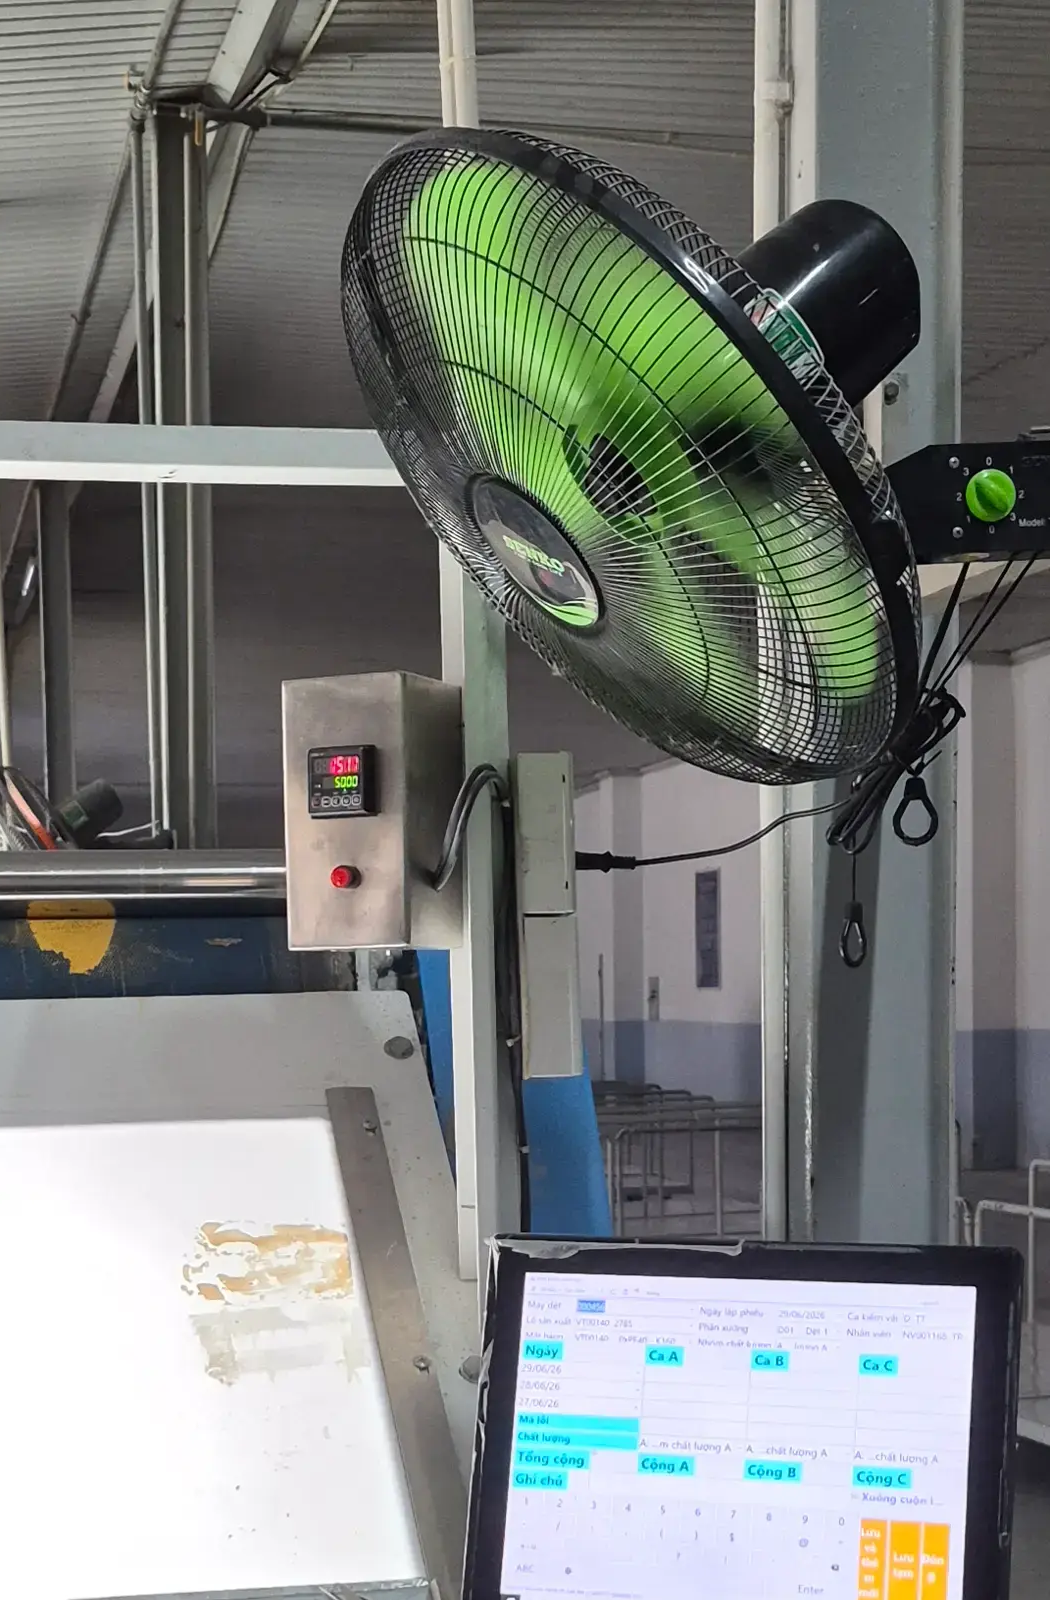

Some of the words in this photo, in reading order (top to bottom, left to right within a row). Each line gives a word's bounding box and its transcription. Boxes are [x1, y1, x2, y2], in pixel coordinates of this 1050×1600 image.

[986, 456, 992, 466] 0
[963, 467, 969, 476] 3
[1009, 465, 1014, 474] 1
[956, 492, 962, 501] 2
[1018, 490, 1025, 499] 2
[966, 515, 970, 523] 1
[1010, 512, 1016, 521] 3
[989, 525, 995, 534] 0
[334, 775, 359, 788] 5000
[649, 1351, 664, 1361] Ca
[669, 1351, 679, 1361] A
[755, 1355, 770, 1366] Ca
[776, 1356, 784, 1366] B
[863, 1359, 879, 1370] Ca
[884, 1360, 893, 1371] C
[641, 1458, 675, 1473] Cộng
[680, 1461, 689, 1471] A
[747, 1464, 782, 1480] Cộng
[788, 1467, 796, 1477] B
[515, 1473, 536, 1485] Ghi
[857, 1471, 892, 1487] Cộng
[898, 1473, 906, 1485] C
[557, 1499, 563, 1508] 2
[625, 1503, 631, 1512] 4
[661, 1505, 666, 1515] 5
[695, 1507, 701, 1517] 6
[731, 1510, 736, 1519] 7
[802, 1515, 808, 1525] 9
[839, 1517, 845, 1526] 0
[798, 1584, 824, 1595] Enter
